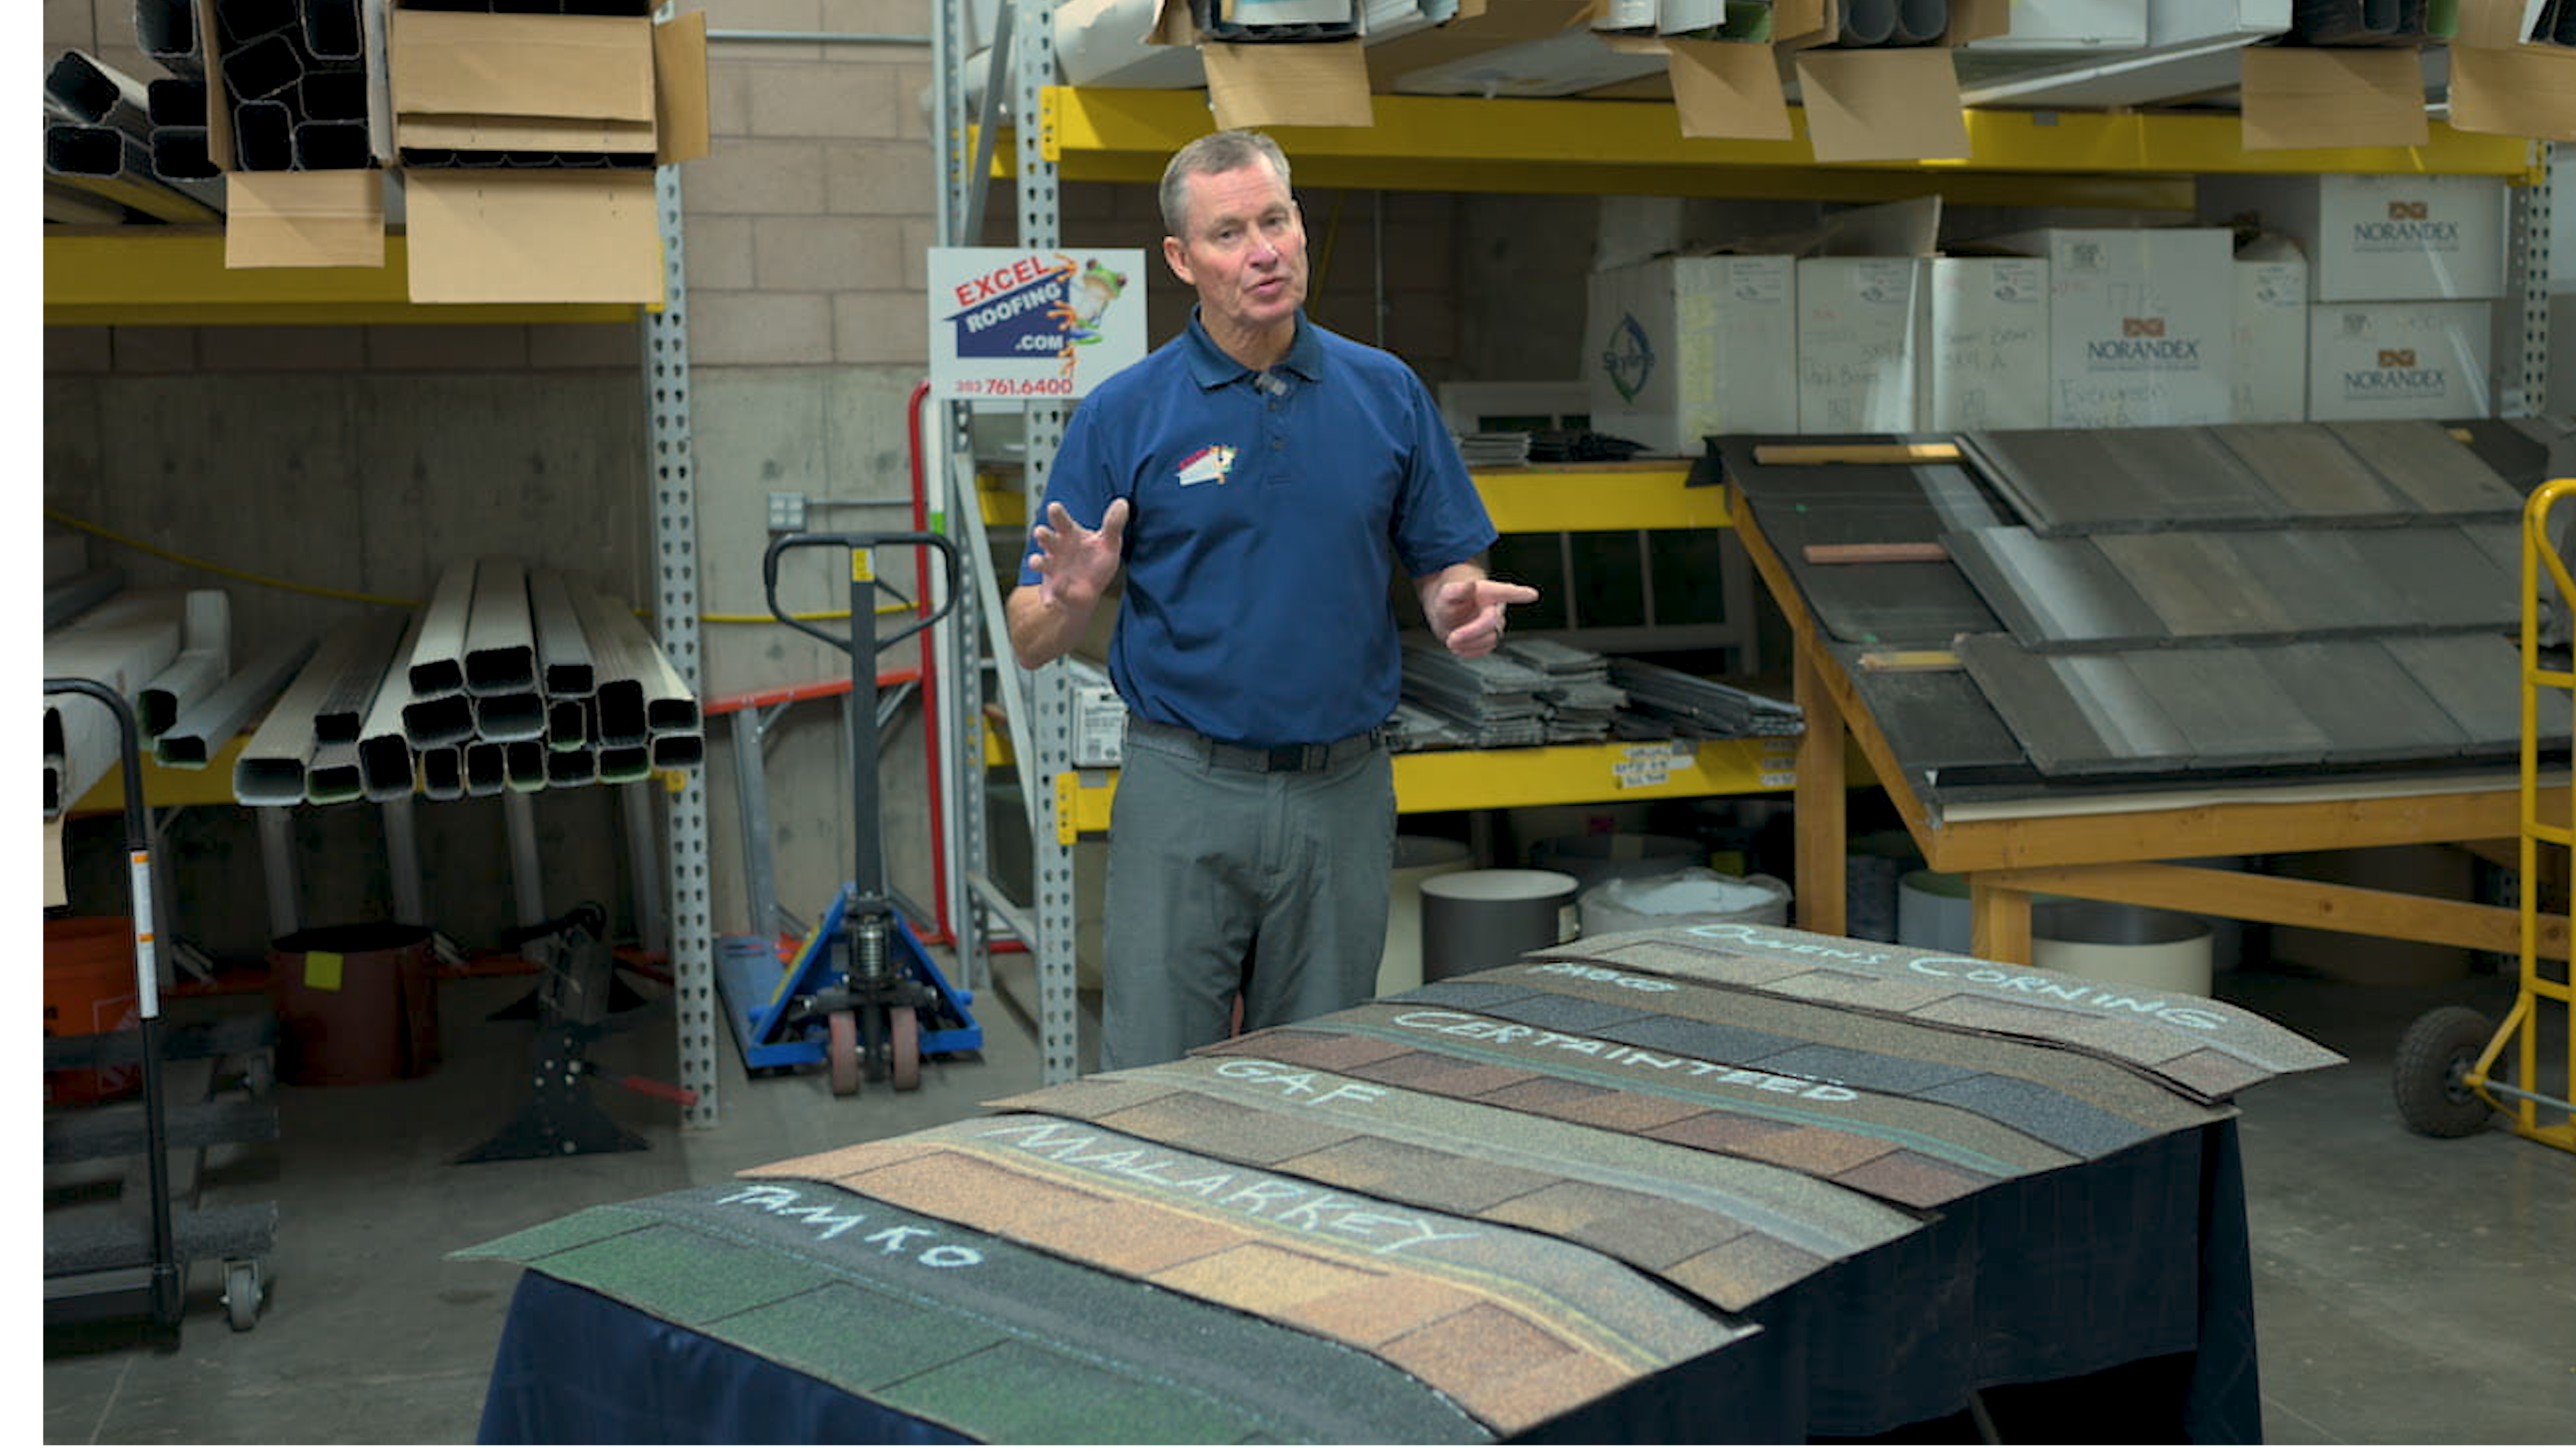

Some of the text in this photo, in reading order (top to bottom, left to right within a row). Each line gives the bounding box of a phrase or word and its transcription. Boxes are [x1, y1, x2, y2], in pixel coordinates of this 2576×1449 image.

[2353, 222, 2460, 241] NORANDEX
[955, 256, 1050, 306] EXCEL
[966, 282, 1061, 333] ROOFING
[1015, 335, 1064, 351] .COM
[2088, 341, 2201, 360] NORANDEX
[985, 378, 1073, 395] 761.6400
[2345, 370, 2445, 389] NORANDEX
[1908, 956, 2231, 1030] CORNING
[1392, 1011, 1860, 1102] CERTAINTEED
[1214, 1059, 1388, 1107] GAF
[975, 1123, 1481, 1254] MALARKEY
[712, 1185, 985, 1267] TAMKO
